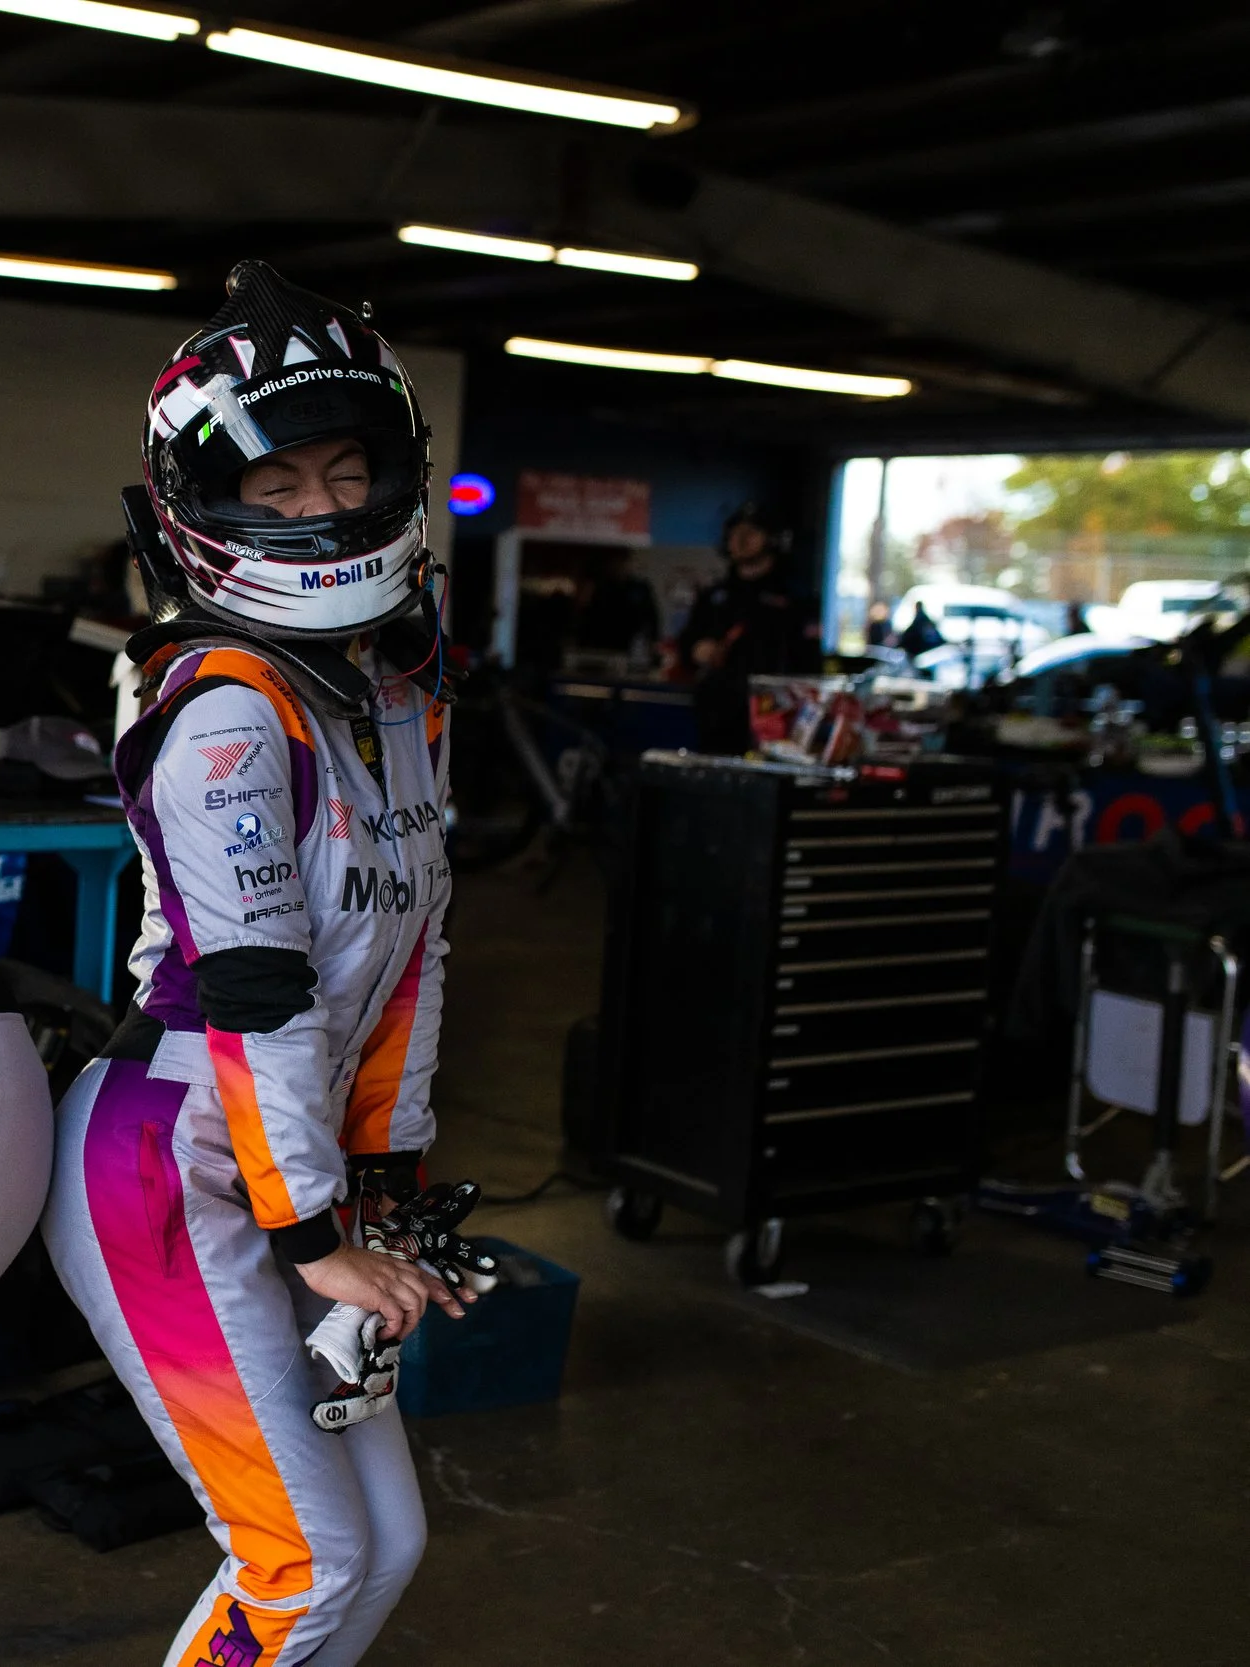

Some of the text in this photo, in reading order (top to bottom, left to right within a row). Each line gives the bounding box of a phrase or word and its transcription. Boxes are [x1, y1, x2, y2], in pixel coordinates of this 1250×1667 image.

[237, 367, 382, 409] RadiusDrive.com
[300, 558, 382, 591] Mobil 1
[189, 733, 210, 741] VOGEL
[237, 740, 266, 777] YOKOHAMA
[205, 789, 268, 811] SHIFT
[242, 895, 254, 903] By
[341, 867, 417, 915] Mobil
